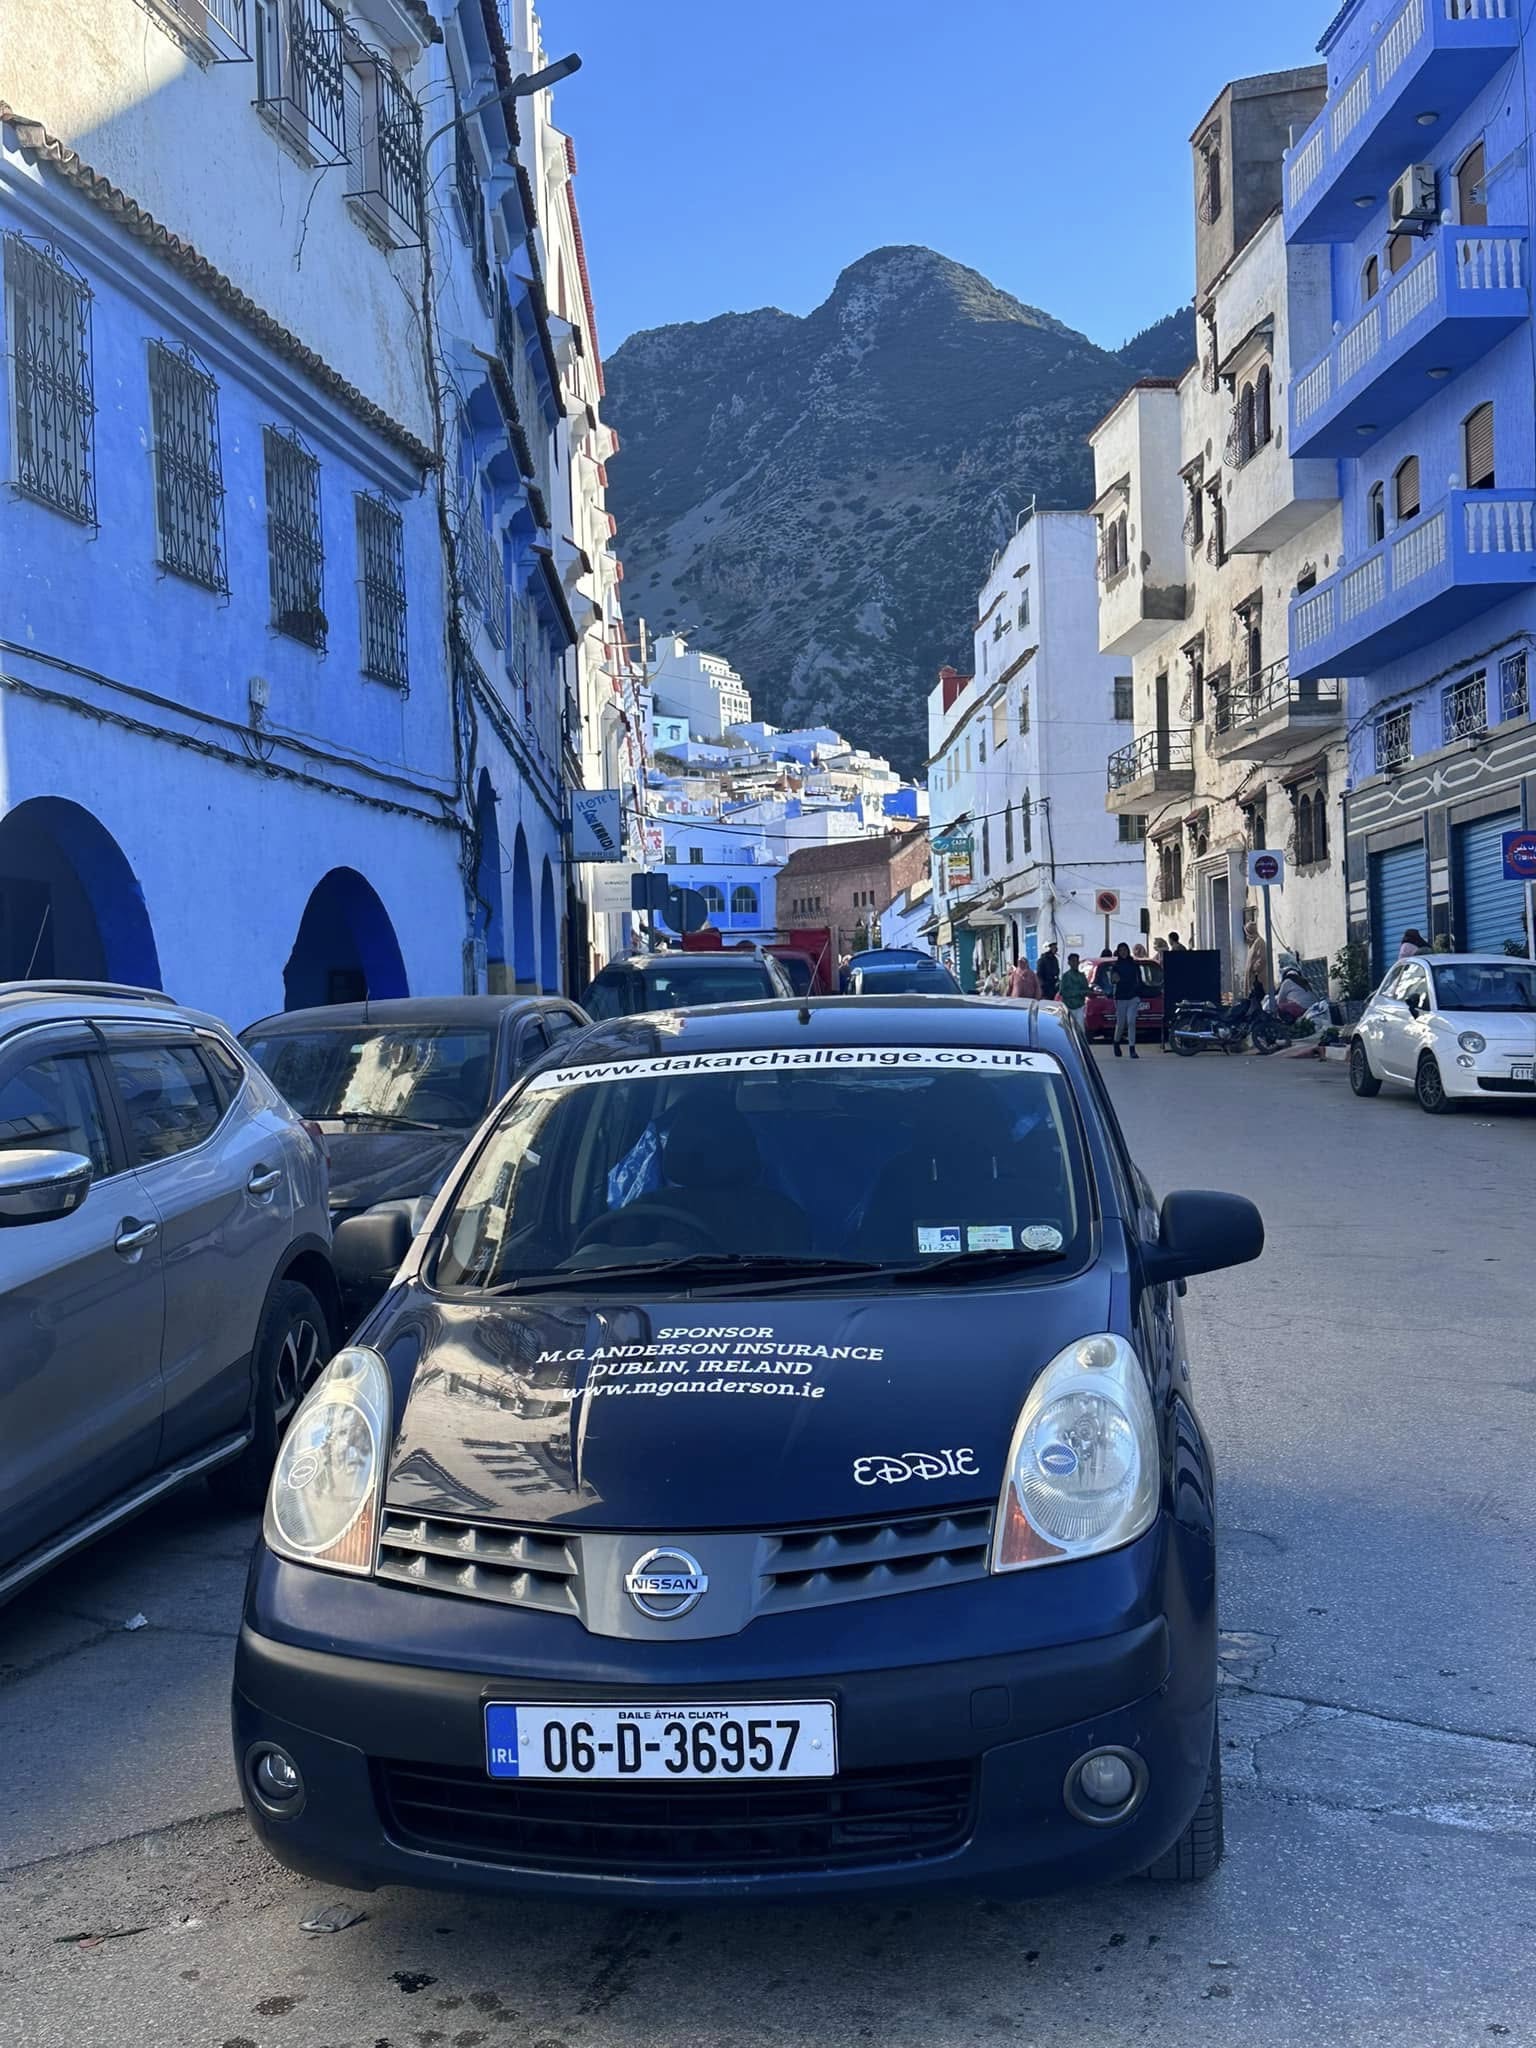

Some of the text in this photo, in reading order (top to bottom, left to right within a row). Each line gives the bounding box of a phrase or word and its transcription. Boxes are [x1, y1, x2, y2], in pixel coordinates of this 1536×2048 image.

[576, 794, 617, 811] HOTEL
[556, 1049, 1034, 1082] www.dakarchallenge.co.uk
[657, 1327, 774, 1339] SPONSOR
[732, 1343, 884, 1361] INSURANCE
[589, 1360, 813, 1377] DUBLIN, IRELAND
[562, 1379, 826, 1399] www.mganderson.ie
[853, 1448, 980, 1485] EDDIE
[632, 1579, 699, 1590] NISSAN
[618, 1709, 729, 1720] BAILE ÁTHA CLIATH
[544, 1720, 800, 1773] 06-D-36957
[492, 1748, 518, 1764] IRL
